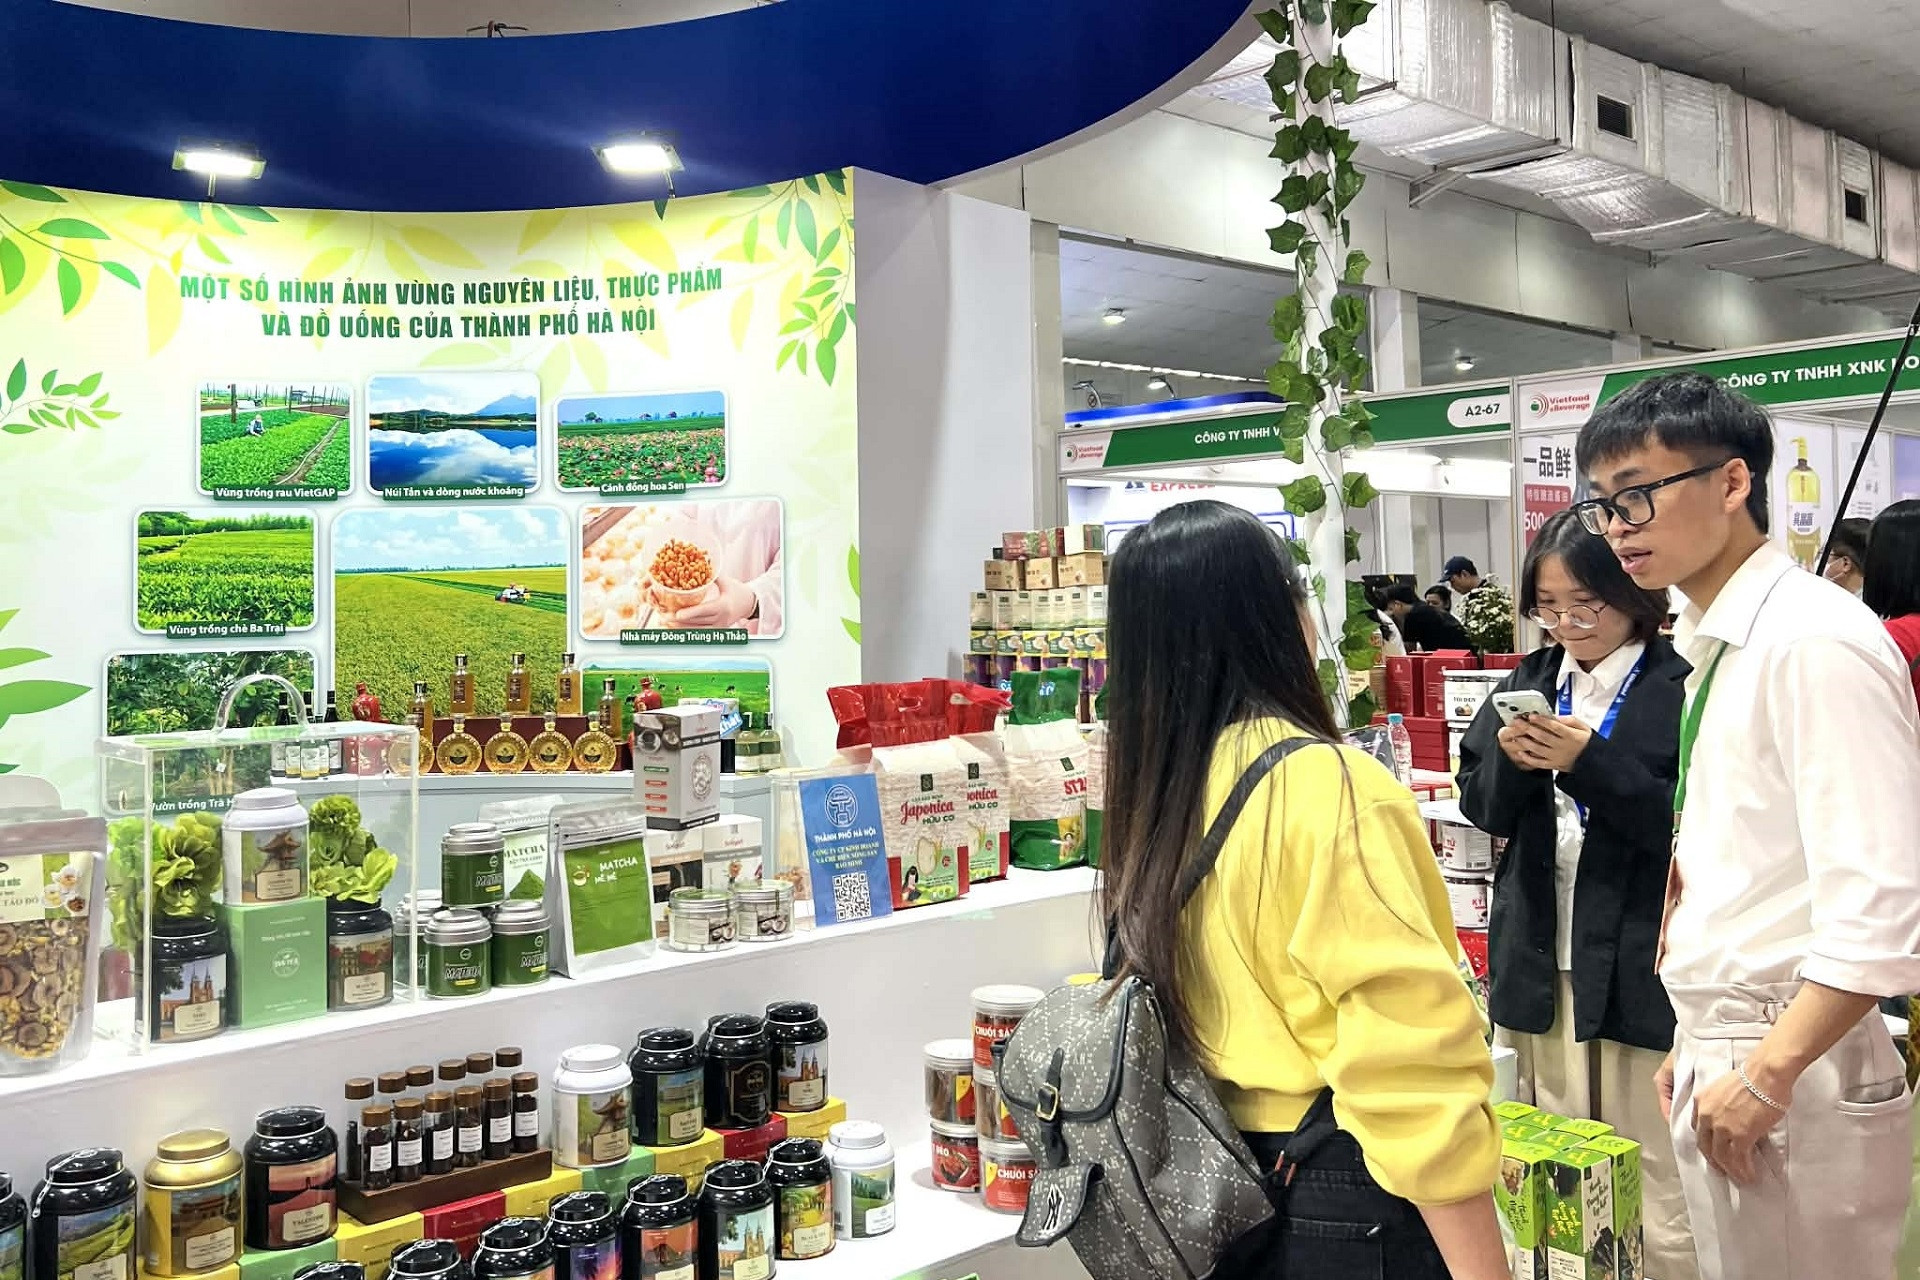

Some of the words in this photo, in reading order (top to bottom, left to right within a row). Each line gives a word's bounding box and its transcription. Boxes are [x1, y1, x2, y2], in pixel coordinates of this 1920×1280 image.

[180, 273, 230, 303] MỘT
[240, 272, 269, 301] SỐ
[279, 277, 334, 304] HÌNH
[342, 277, 387, 305] ẢNH
[395, 279, 454, 305] VÙNG
[463, 278, 545, 304] NGUYÊN
[553, 275, 599, 304] LIỆU,
[606, 271, 660, 302] THỰC
[667, 262, 722, 294] PHẨM
[261, 311, 291, 336] VÀ
[300, 308, 330, 337] ĐỒ
[339, 309, 400, 338] UỐNG
[409, 311, 454, 338] CỦA
[461, 312, 531, 338] THÀNH
[539, 301, 579, 336] PHỐ
[587, 308, 614, 334] HÀ
[621, 305, 656, 335] NỘI
[1717, 373, 1767, 390] CÔNG
[1771, 370, 1791, 384] TY
[1795, 364, 1842, 382] TNHH
[1847, 359, 1886, 376] XNK
[1549, 394, 1590, 404] Vietfood
[1465, 403, 1501, 417] A2-67
[1194, 432, 1226, 444] CÔNG
[1228, 430, 1240, 441] TY
[1242, 427, 1270, 440] TNHH
[1523, 446, 1571, 479] 一品鲜
[384, 487, 402, 497] Núi
[422, 487, 434, 496] và
[436, 487, 461, 498] dòng
[463, 487, 486, 497] nước
[488, 486, 524, 497] khoáng
[650, 482, 667, 490] hoa
[667, 481, 684, 490] Sen
[216, 487, 243, 499] Vùng
[275, 489, 292, 497] rau
[294, 488, 336, 497] VietGAP
[169, 625, 197, 636] Vùng
[229, 624, 248, 633] chè
[250, 624, 263, 633] Ba
[264, 623, 284, 635] Trại
[621, 631, 639, 641] Nhà
[641, 632, 661, 643] máy
[661, 631, 685, 643] Đông
[686, 631, 711, 643] Trùng
[713, 631, 724, 643] Hạ
[209, 798, 225, 808] Trà
[900, 800, 955, 825] Japonica
[814, 832, 837, 843] THÀNH
[838, 828, 852, 840] PHỐ
[853, 828, 863, 838] HÀ
[864, 826, 877, 840] NỘI
[600, 856, 639, 872] MATCHA
[975, 1026, 996, 1038] CHUỐI
[997, 1167, 1026, 1180] CHUỐI
